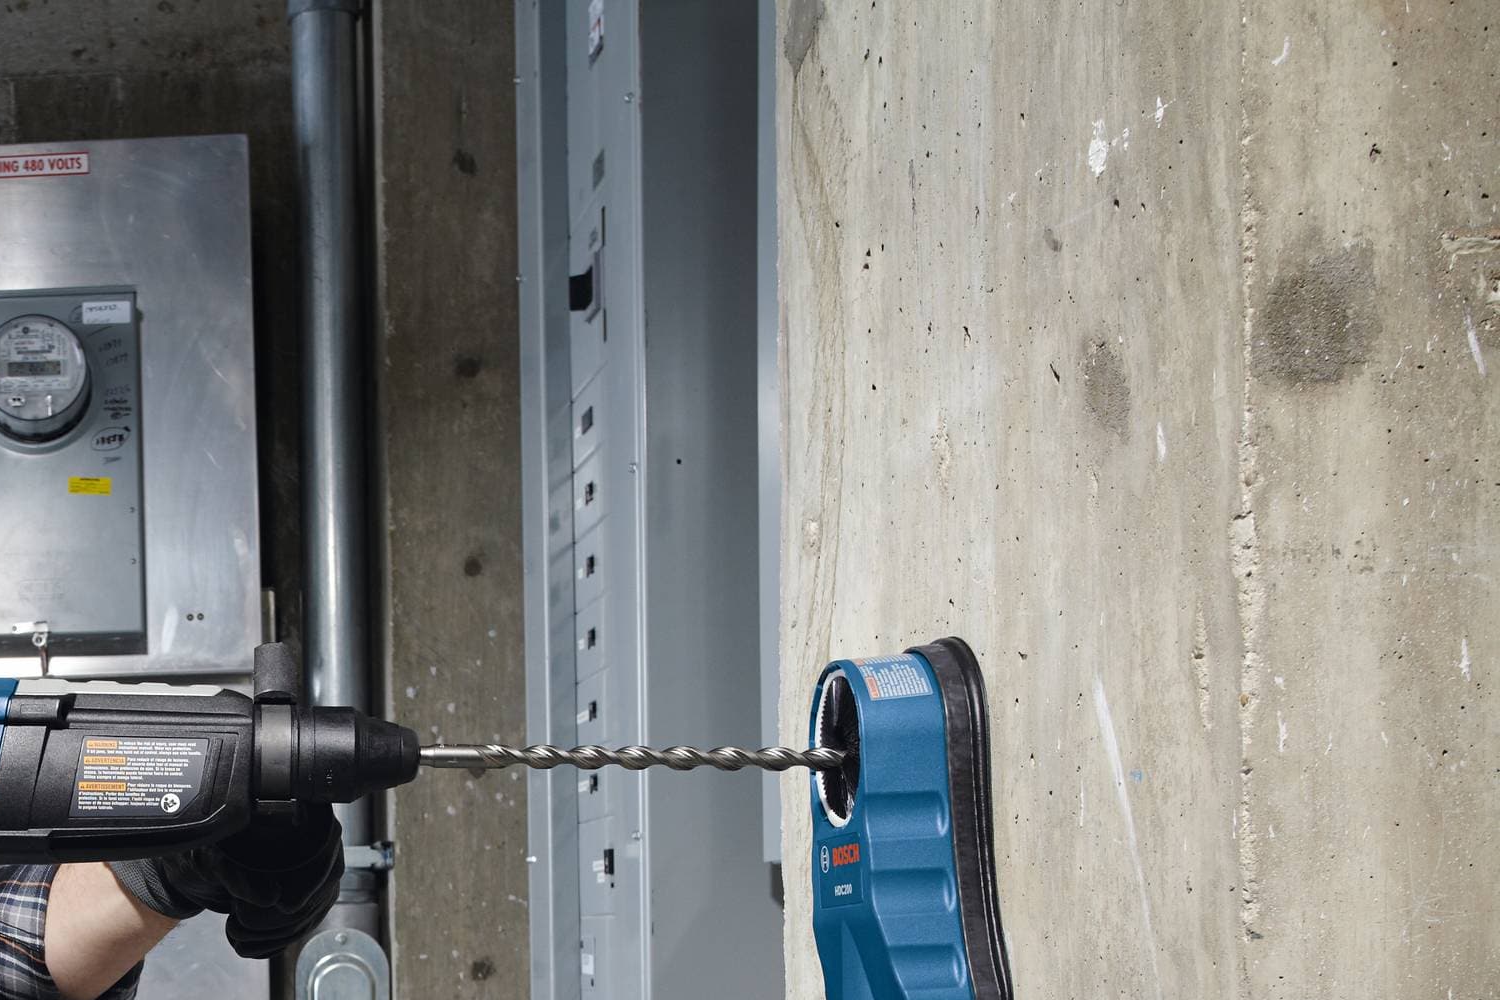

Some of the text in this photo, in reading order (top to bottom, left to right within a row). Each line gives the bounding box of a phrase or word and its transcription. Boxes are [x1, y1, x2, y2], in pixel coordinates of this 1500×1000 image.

[22, 159, 45, 172] 480
[48, 157, 82, 170] VOLTS
[832, 843, 860, 867] BOSCH
